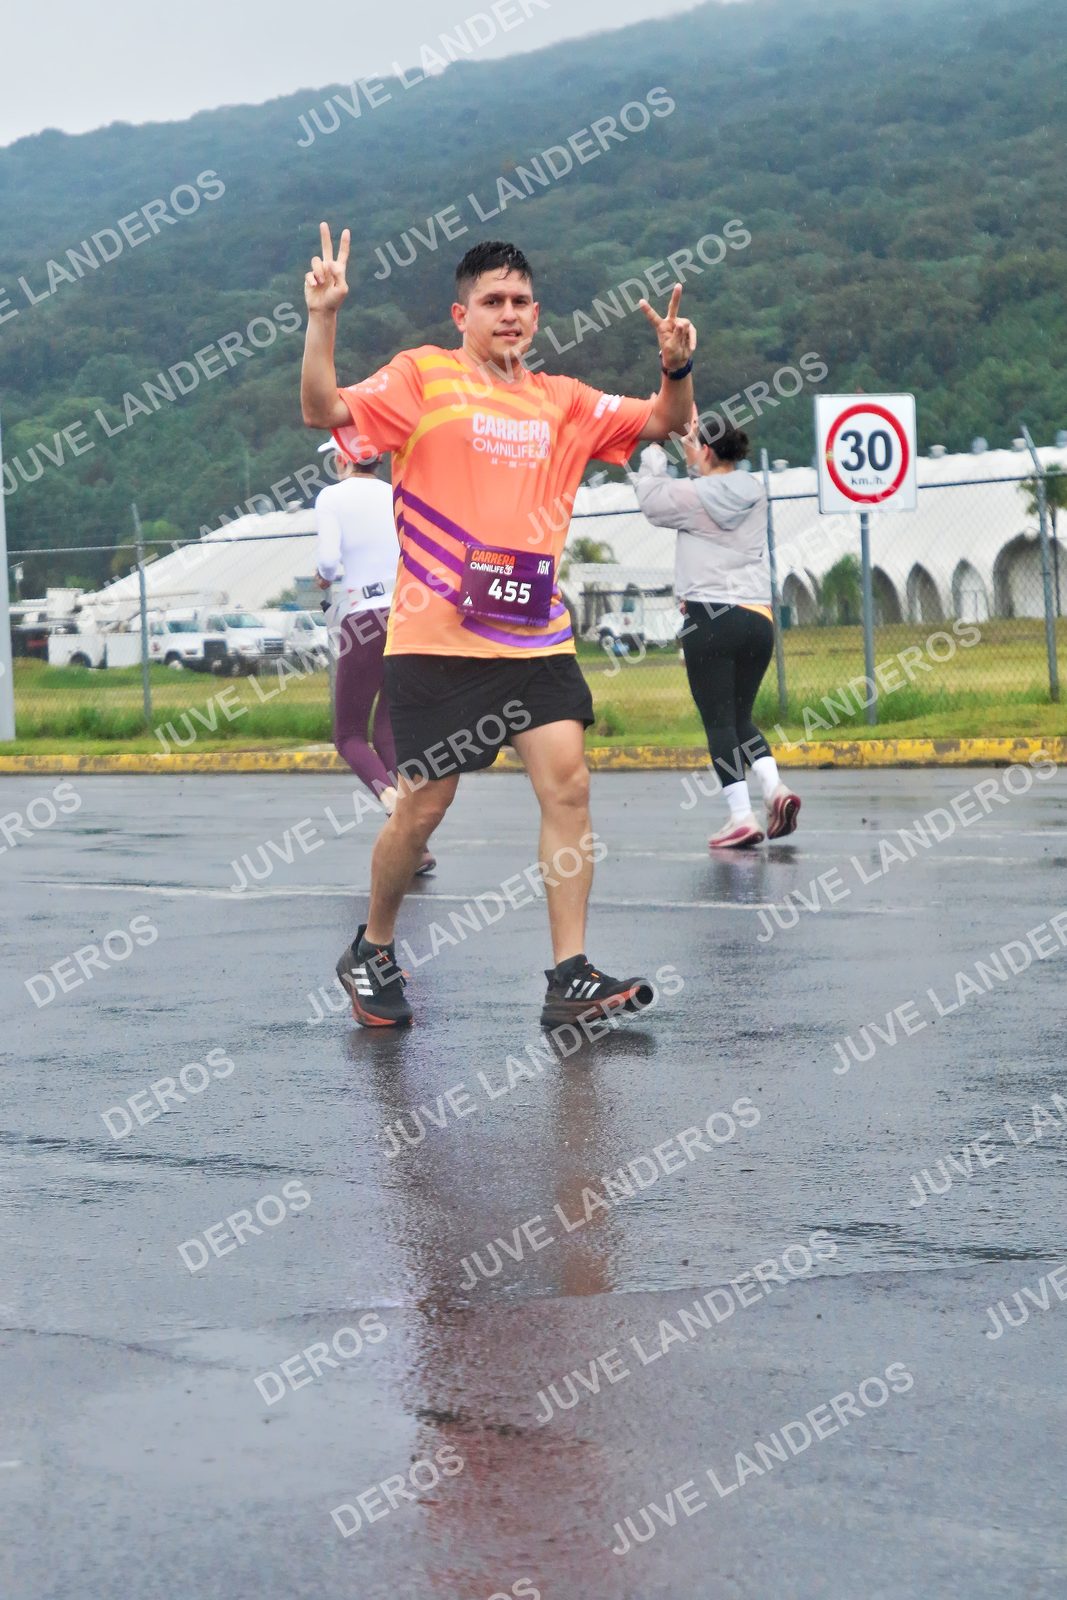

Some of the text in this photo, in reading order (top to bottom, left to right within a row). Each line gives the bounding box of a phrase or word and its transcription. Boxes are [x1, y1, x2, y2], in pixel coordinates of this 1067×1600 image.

[473, 412, 550, 443] CARRERA
[841, 430, 892, 471] 30
[472, 550, 515, 565] CARRERA
[488, 578, 532, 604] 455
